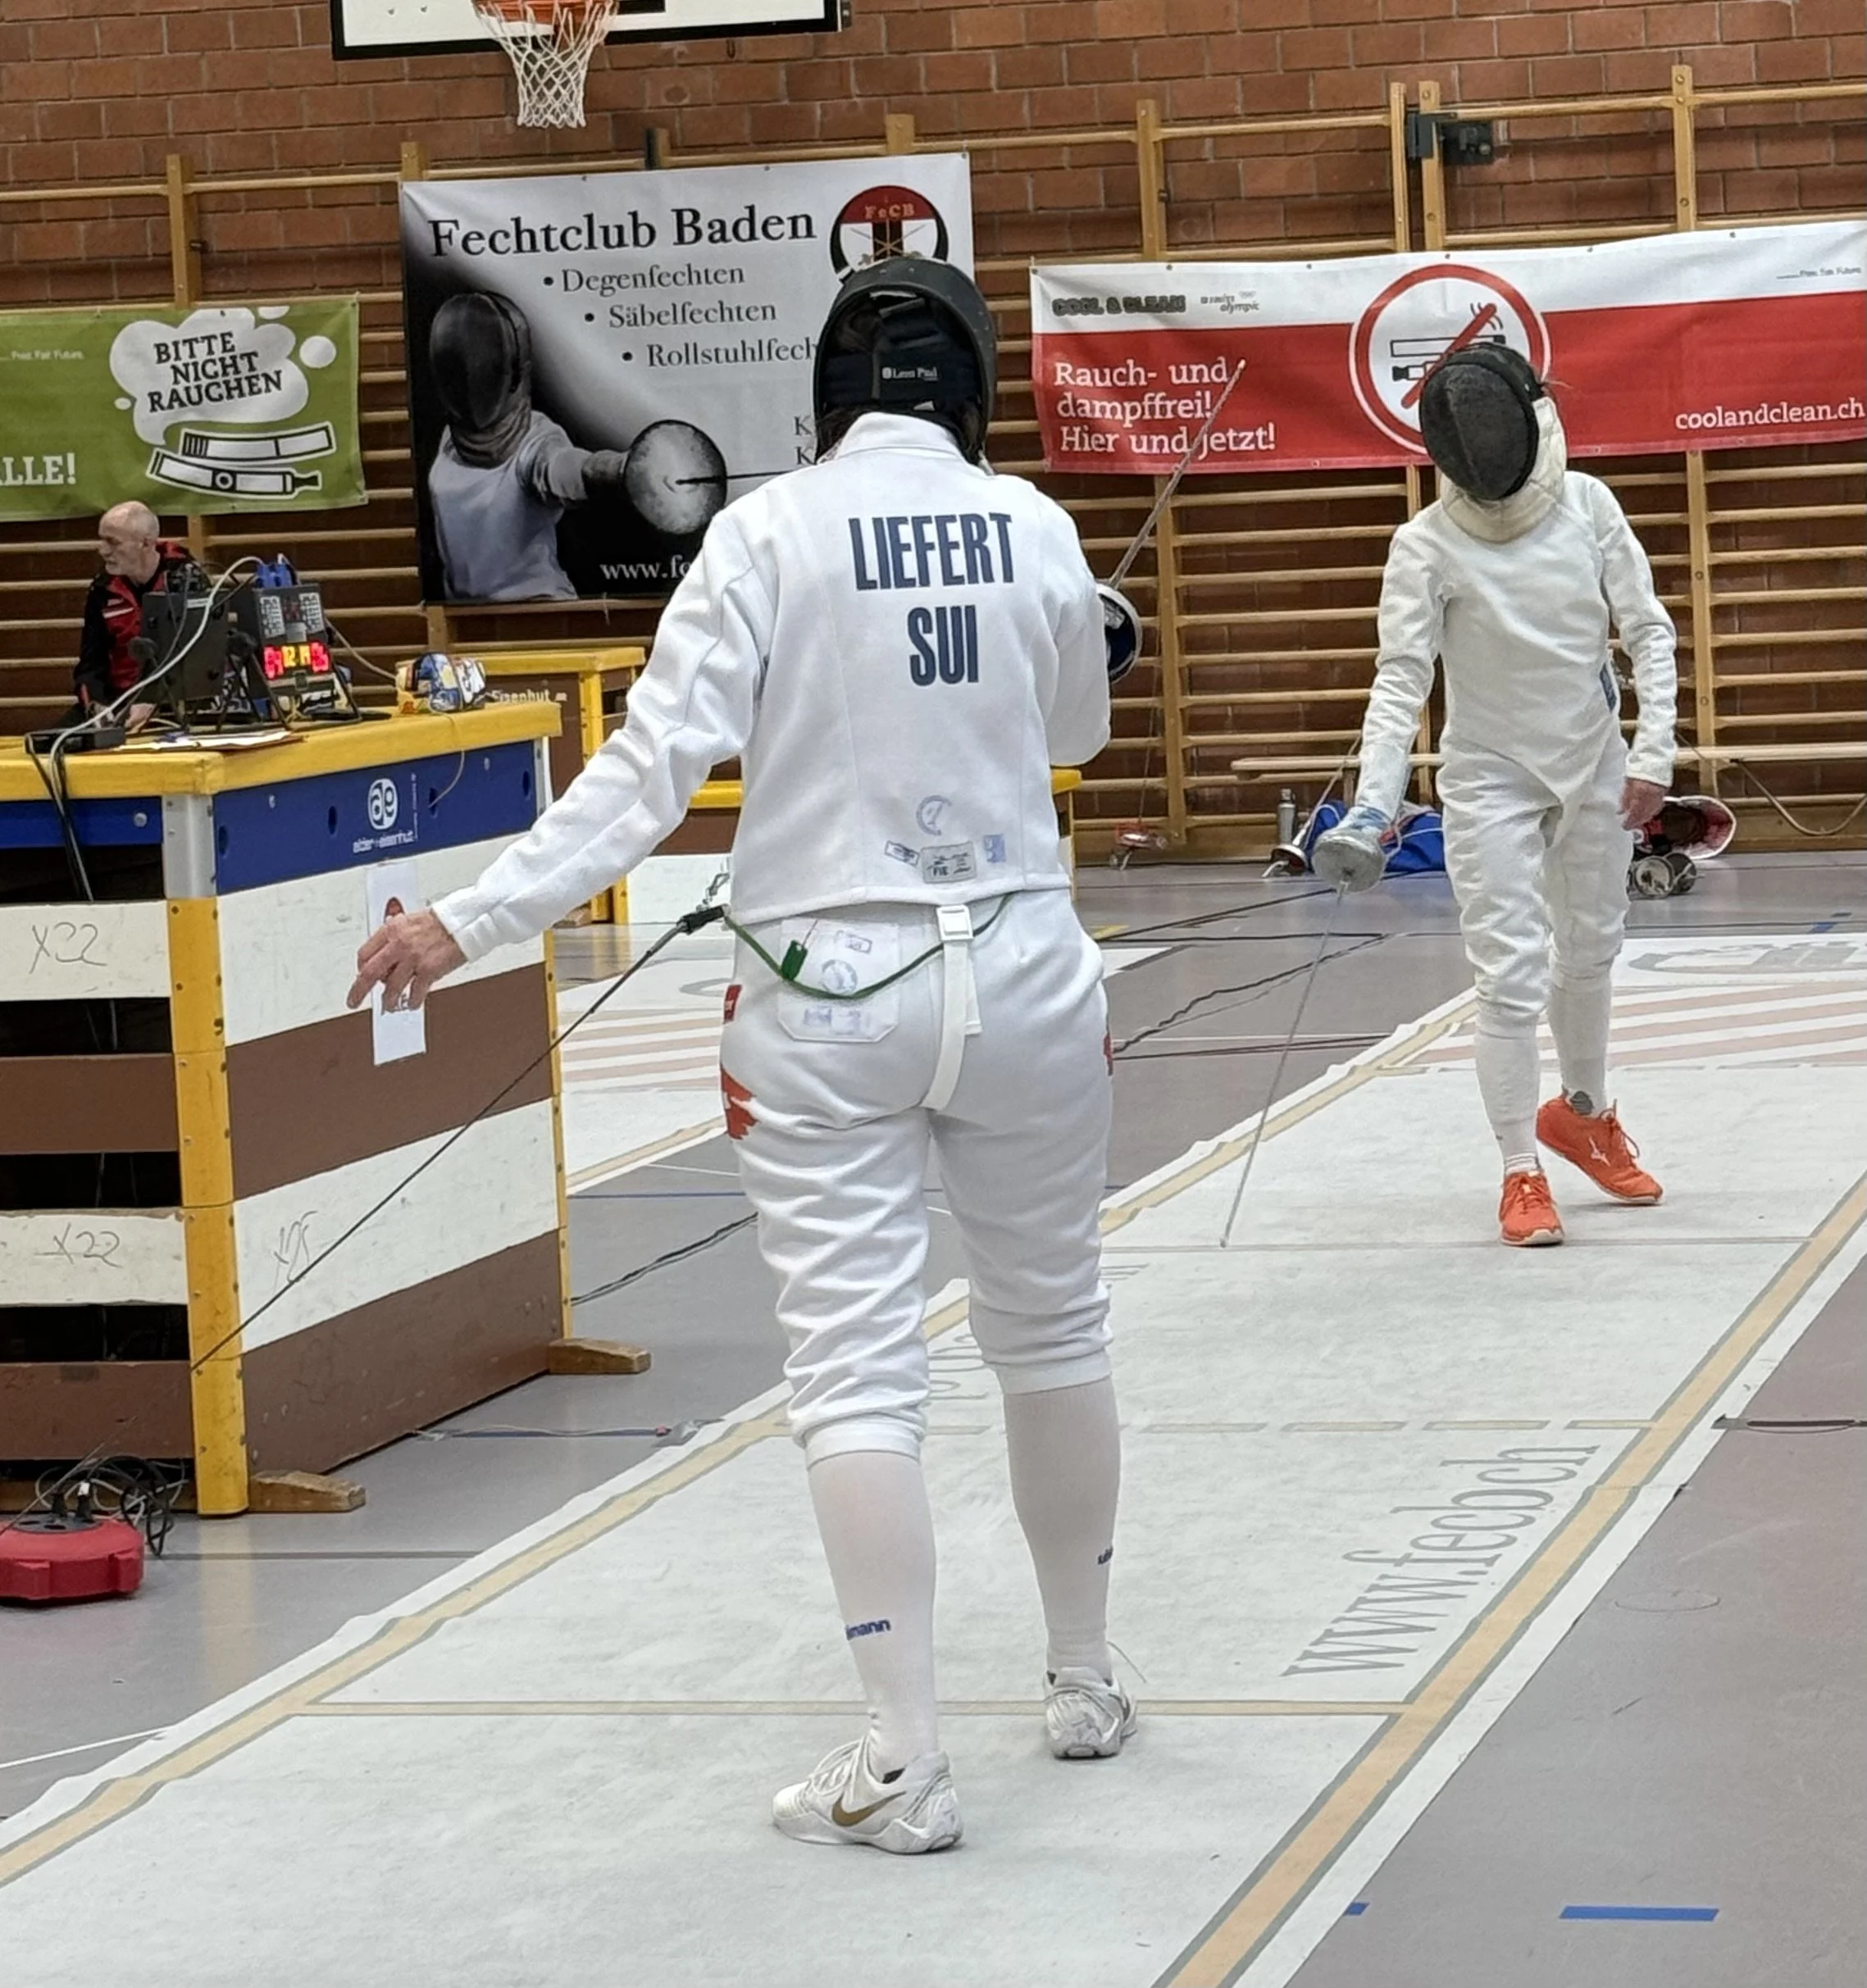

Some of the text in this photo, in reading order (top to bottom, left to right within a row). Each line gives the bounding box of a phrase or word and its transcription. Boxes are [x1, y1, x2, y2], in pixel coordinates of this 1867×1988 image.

[865, 203, 915, 220] FeCB
[427, 203, 817, 258] Fechtclub Baden
[562, 263, 745, 298] Degenfechten
[608, 300, 777, 329] Säbelfechten
[1051, 297, 1104, 316] COOL
[153, 331, 235, 365] BITTE
[169, 351, 259, 385] NICHT
[1054, 356, 1229, 388] Rauch- und
[148, 370, 283, 413] RAUCHEN
[1056, 390, 1213, 427] dampffrei!
[1675, 397, 1866, 430] coolandclean.ch
[1059, 421, 1277, 460] Hier und jetzt!
[0, 452, 76, 485] LLE!
[849, 512, 1015, 591] LIEFERT
[906, 604, 979, 687] SUI
